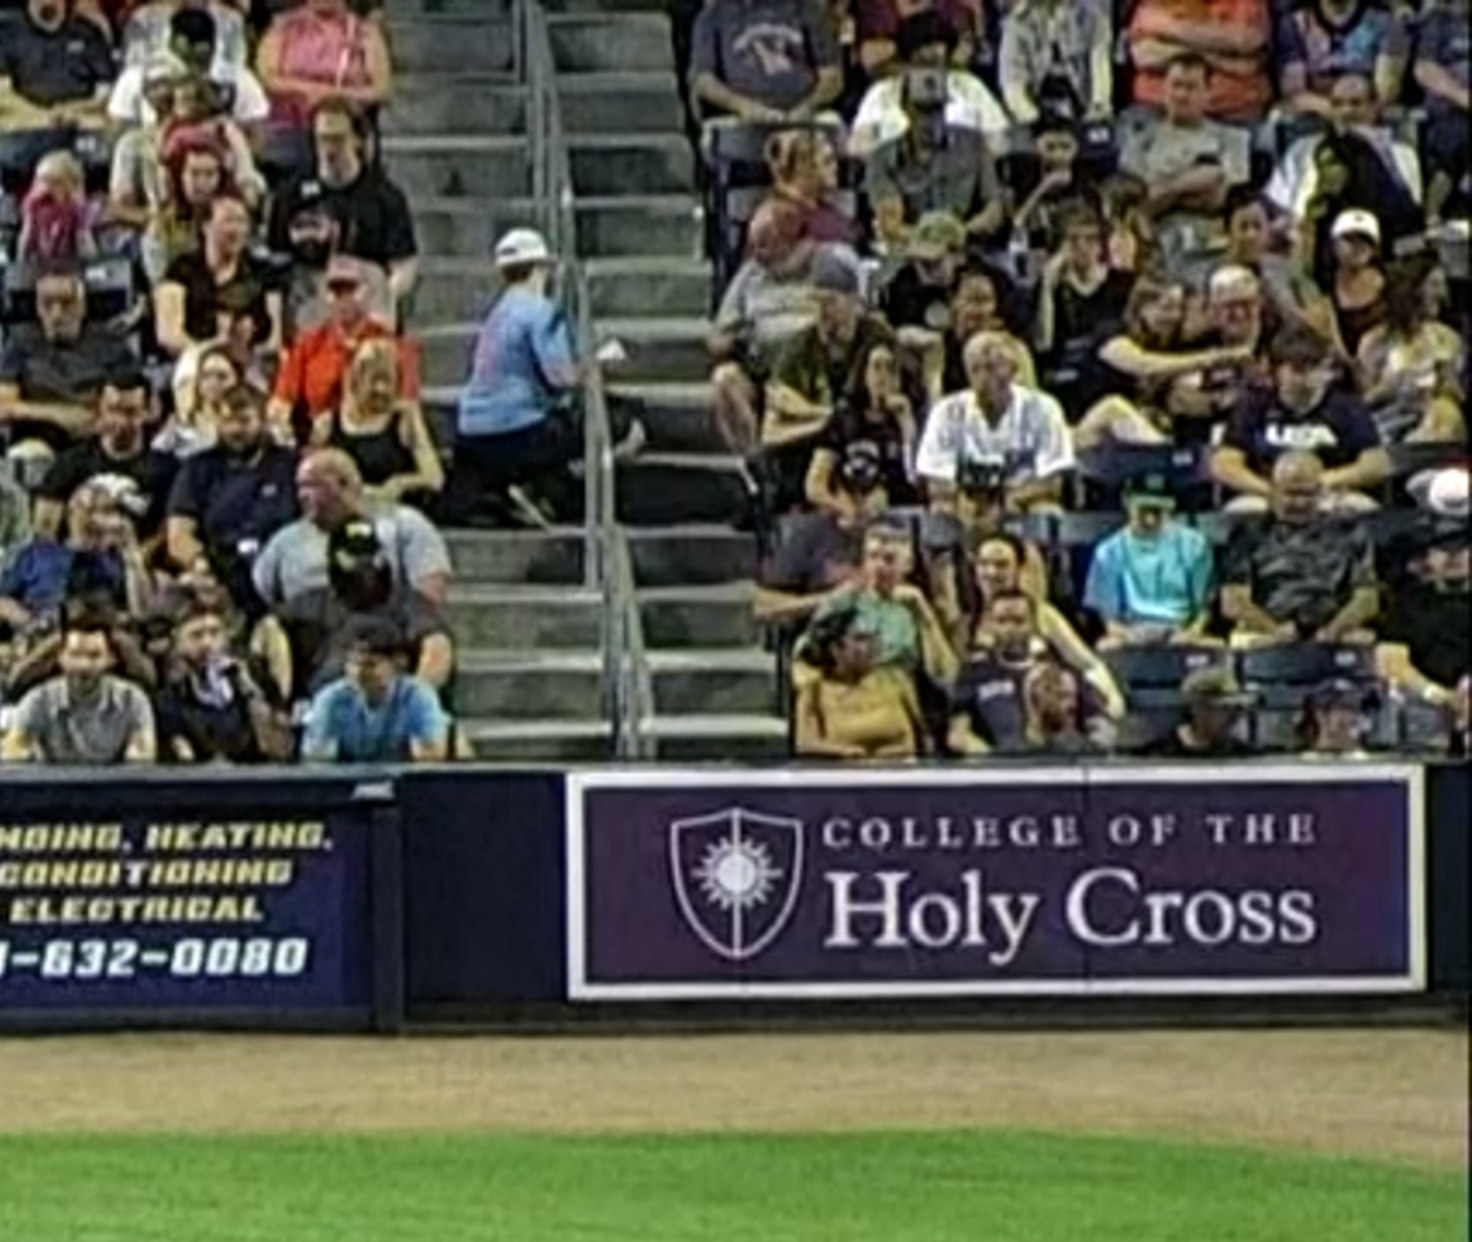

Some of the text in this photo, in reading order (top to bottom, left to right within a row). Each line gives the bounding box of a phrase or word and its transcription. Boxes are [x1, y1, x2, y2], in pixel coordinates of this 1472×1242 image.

[145, 822, 333, 851] HEATING,
[823, 813, 1316, 847] COLLEGE OF THE
[9, 895, 263, 924] ELECTRICAL
[825, 869, 1317, 966] Holy Cross
